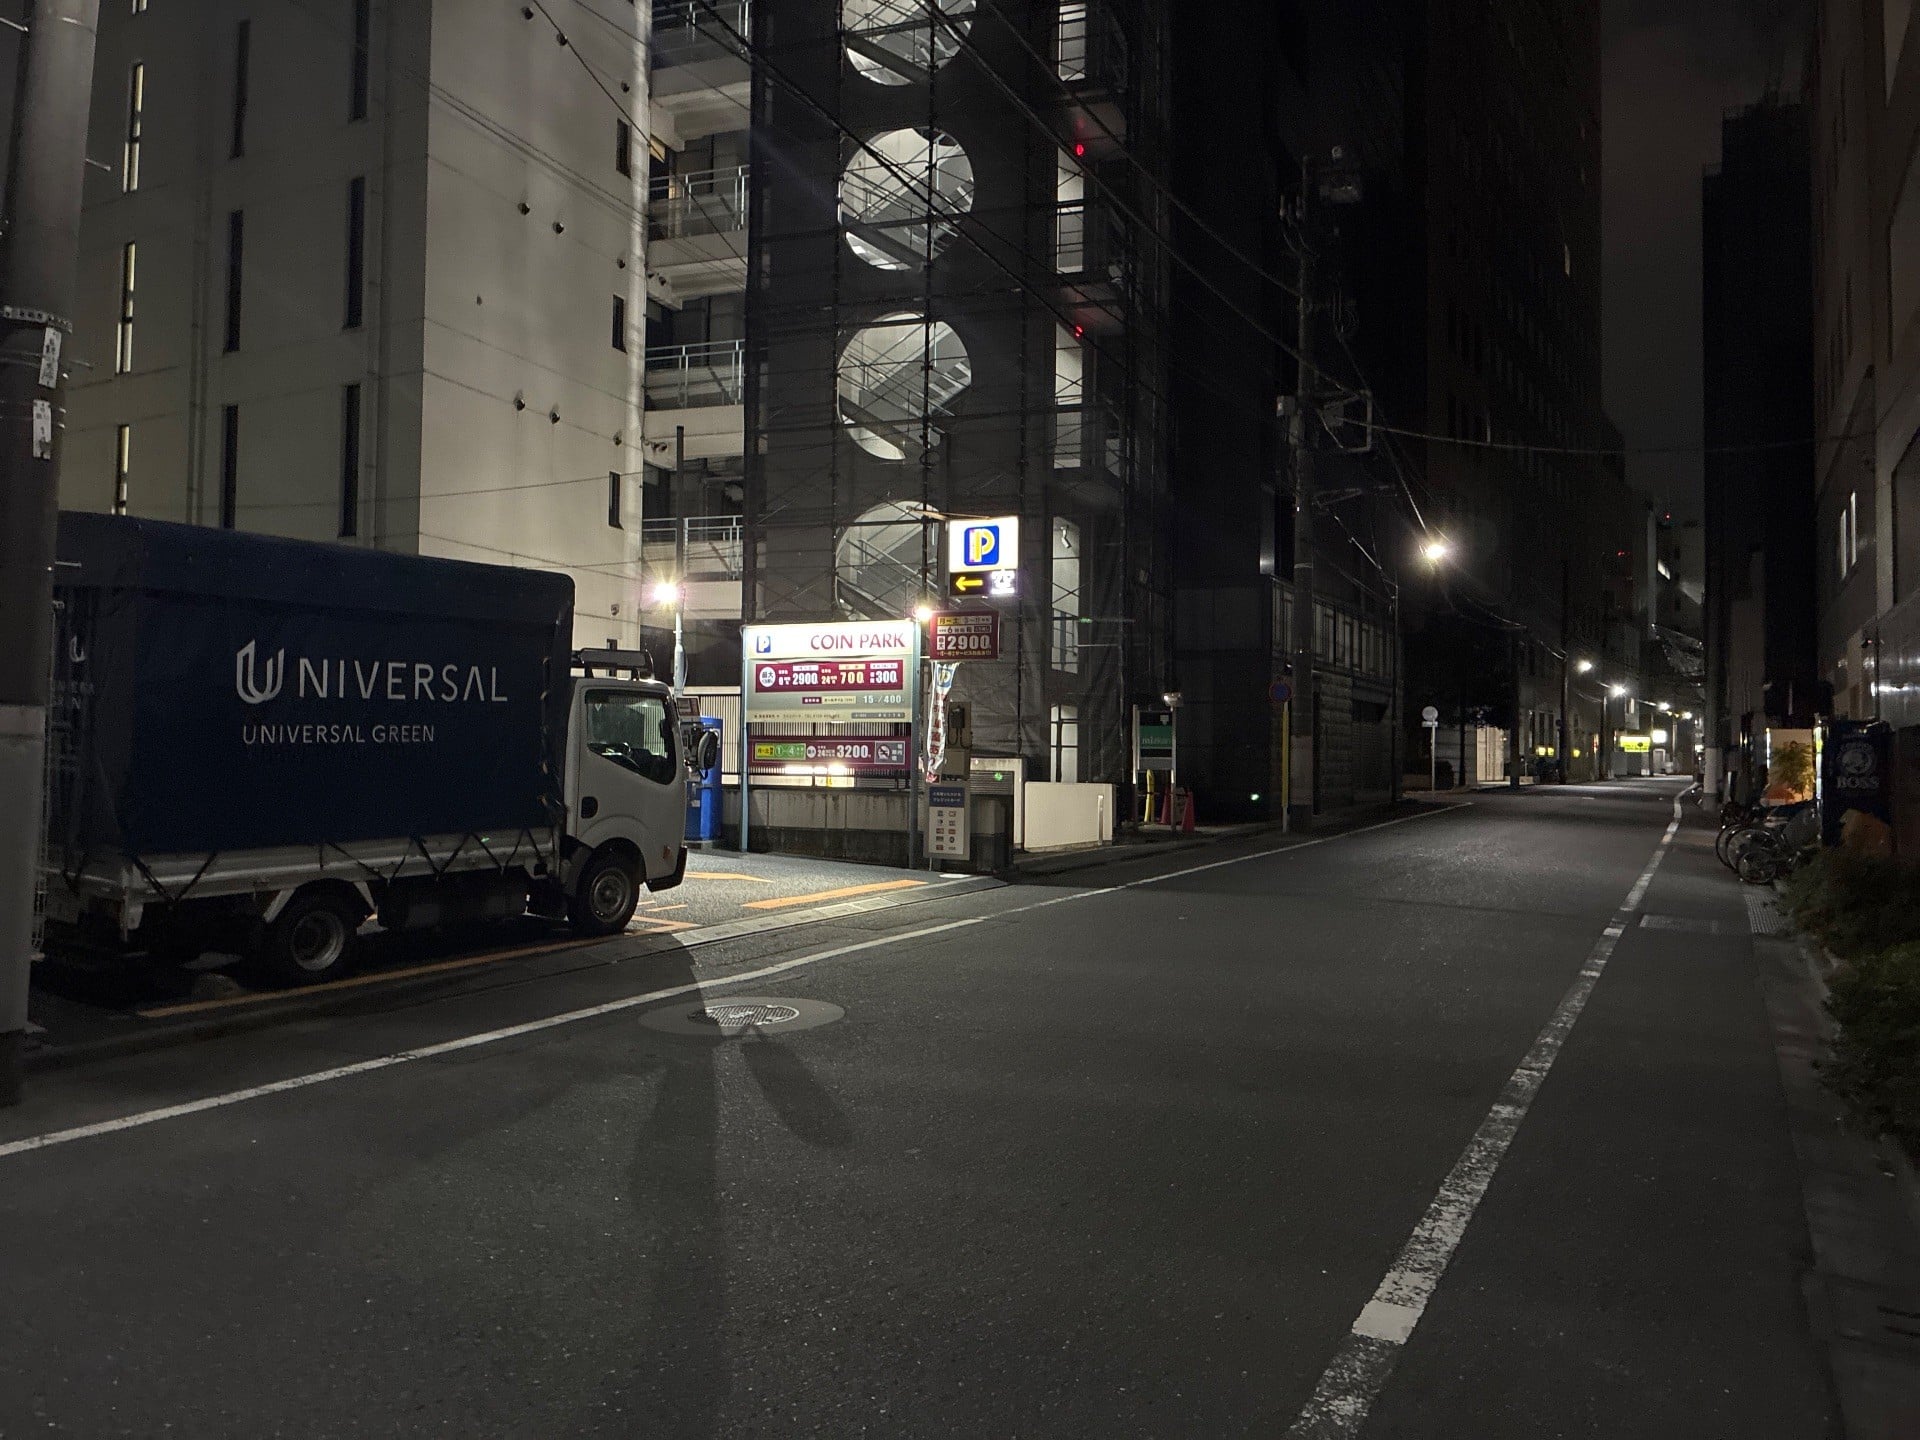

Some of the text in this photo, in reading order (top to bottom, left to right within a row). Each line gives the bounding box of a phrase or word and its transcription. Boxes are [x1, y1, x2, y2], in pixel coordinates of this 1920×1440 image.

[969, 528, 995, 562] P
[810, 633, 905, 650] COIN PARK
[236, 639, 508, 704] UNIVERSAL
[243, 724, 434, 745] UNIVERSAL GREEN
[836, 745, 868, 758] 3200
